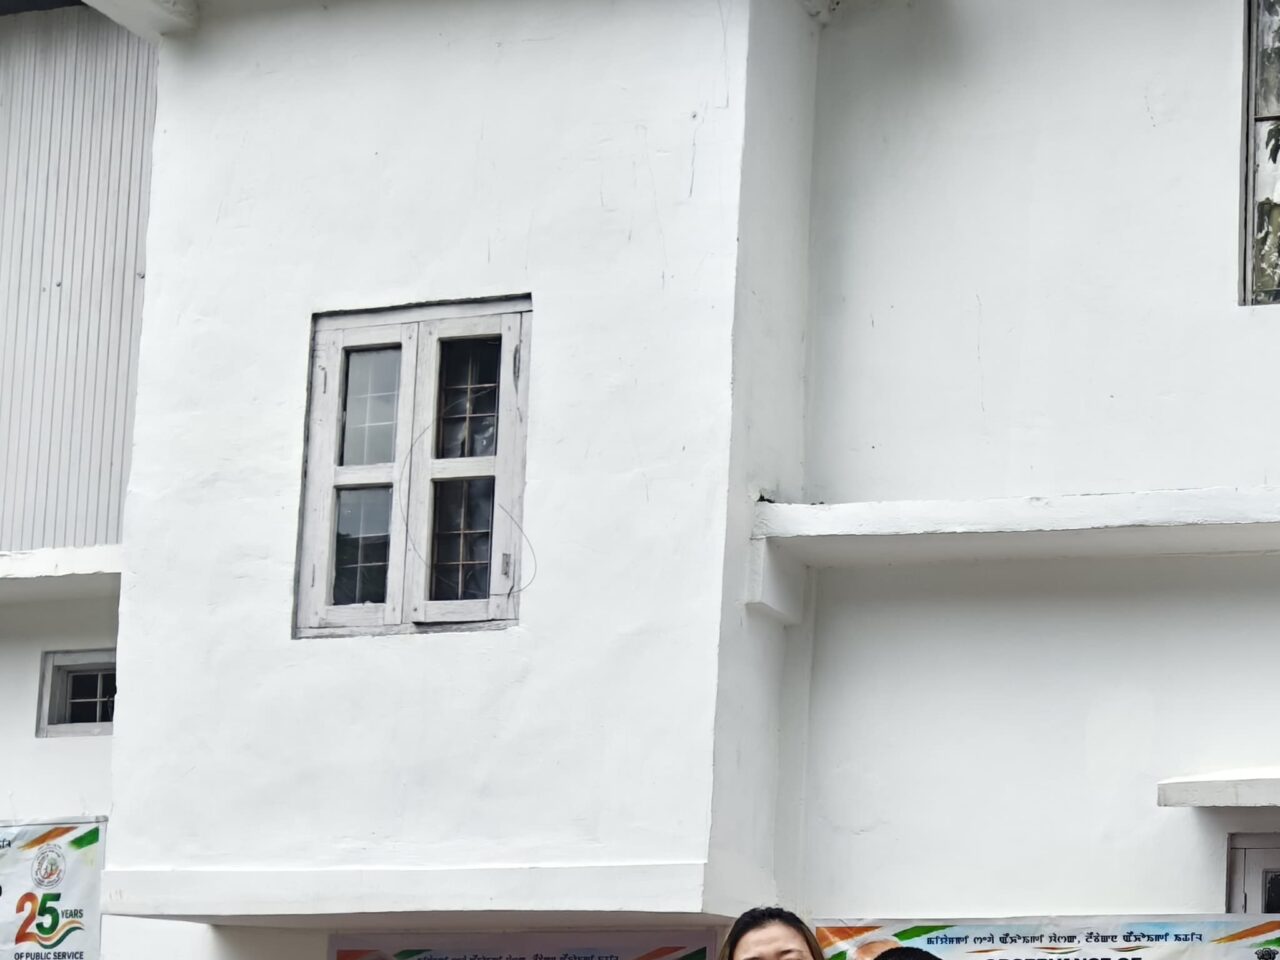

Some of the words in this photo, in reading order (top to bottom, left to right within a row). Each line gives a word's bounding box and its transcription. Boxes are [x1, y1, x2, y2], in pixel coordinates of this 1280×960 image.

[15, 892, 61, 945] 25
[61, 909, 83, 919] YEARS
[14, 952, 24, 960] OF
[25, 952, 51, 960] PUBLIC
[53, 951, 84, 960] SERVICE
